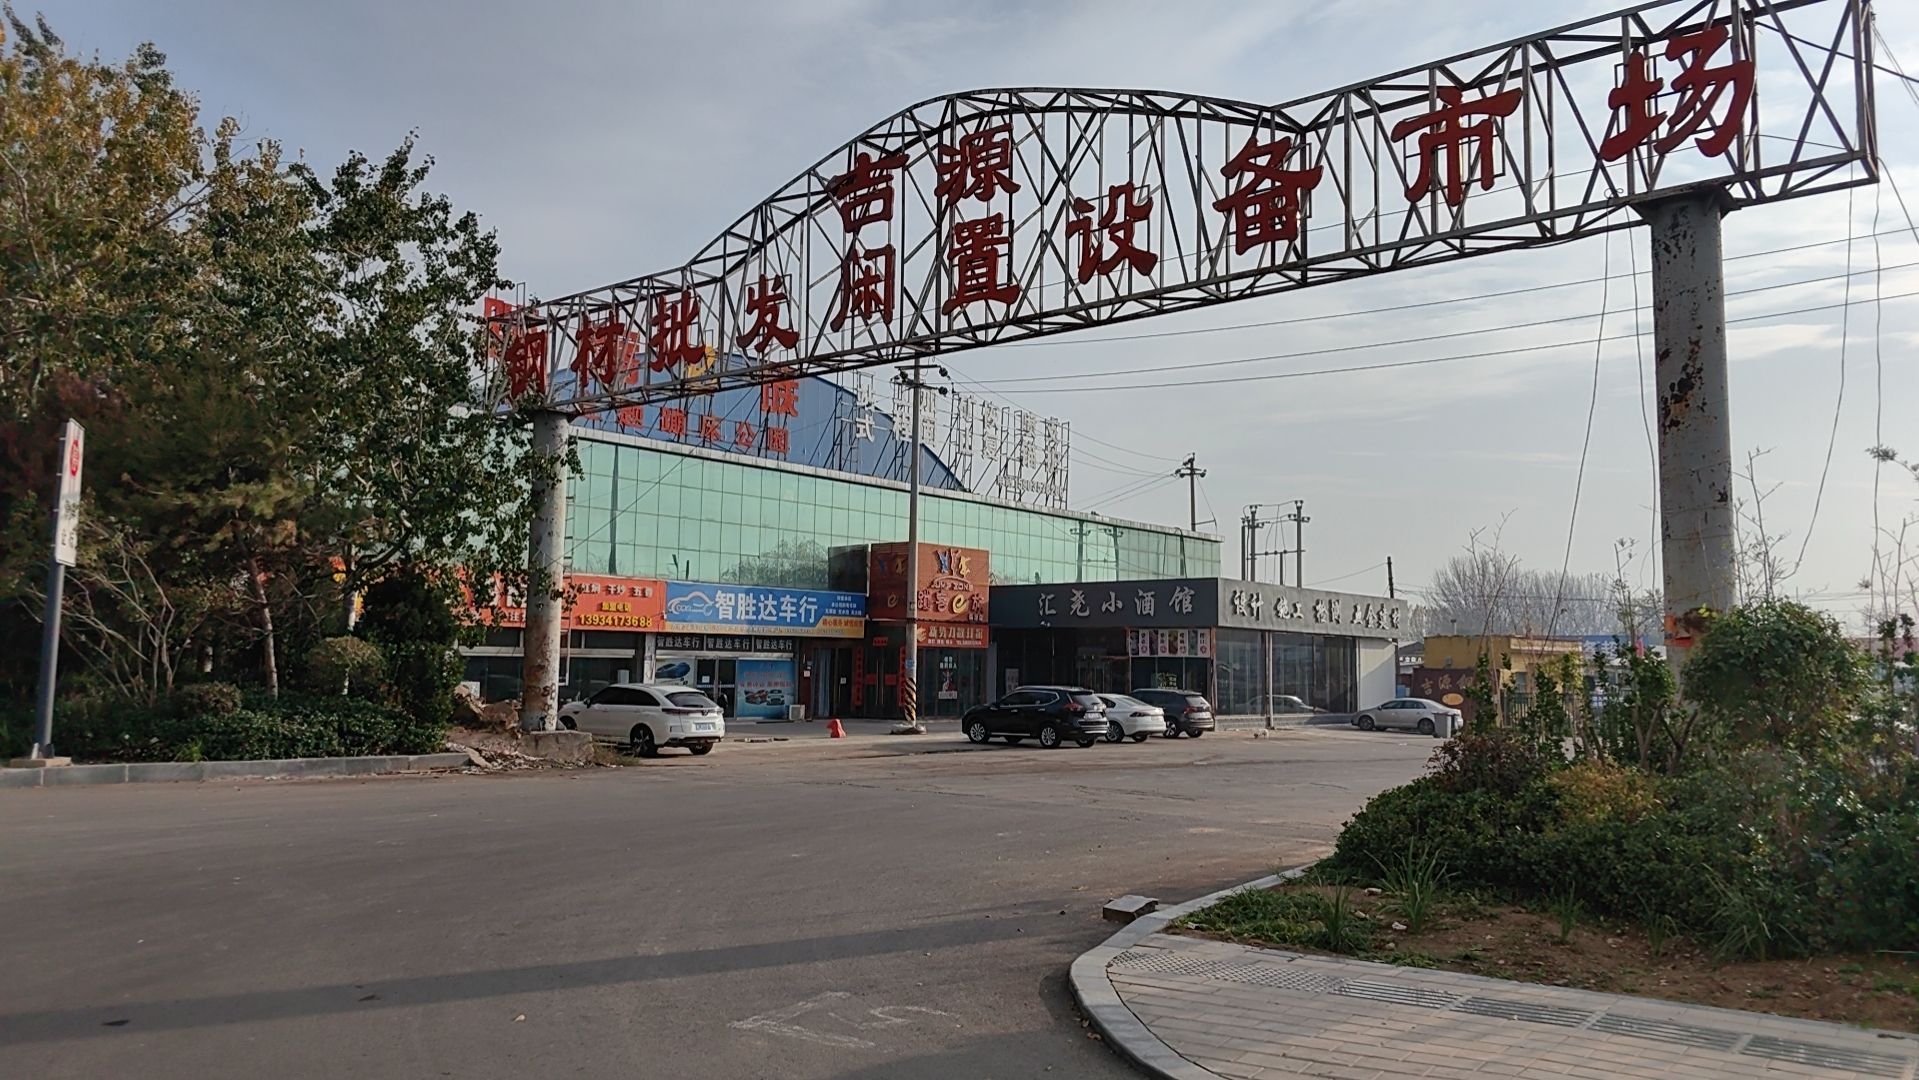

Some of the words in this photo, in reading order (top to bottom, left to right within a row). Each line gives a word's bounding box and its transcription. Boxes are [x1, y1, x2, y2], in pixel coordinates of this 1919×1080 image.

[827, 123, 1020, 234] 吉源
[715, 589, 818, 624] 智胜达车行
[1038, 586, 1195, 617] 汇尧小酒馆
[1234, 590, 1264, 621] 设计
[1276, 596, 1304, 620] 施工
[580, 613, 653, 628] 13934173688
[657, 636, 700, 650] 智胜达车行
[707, 637, 750, 650] 智胜达车行
[756, 638, 793, 651] 智胜达车行
